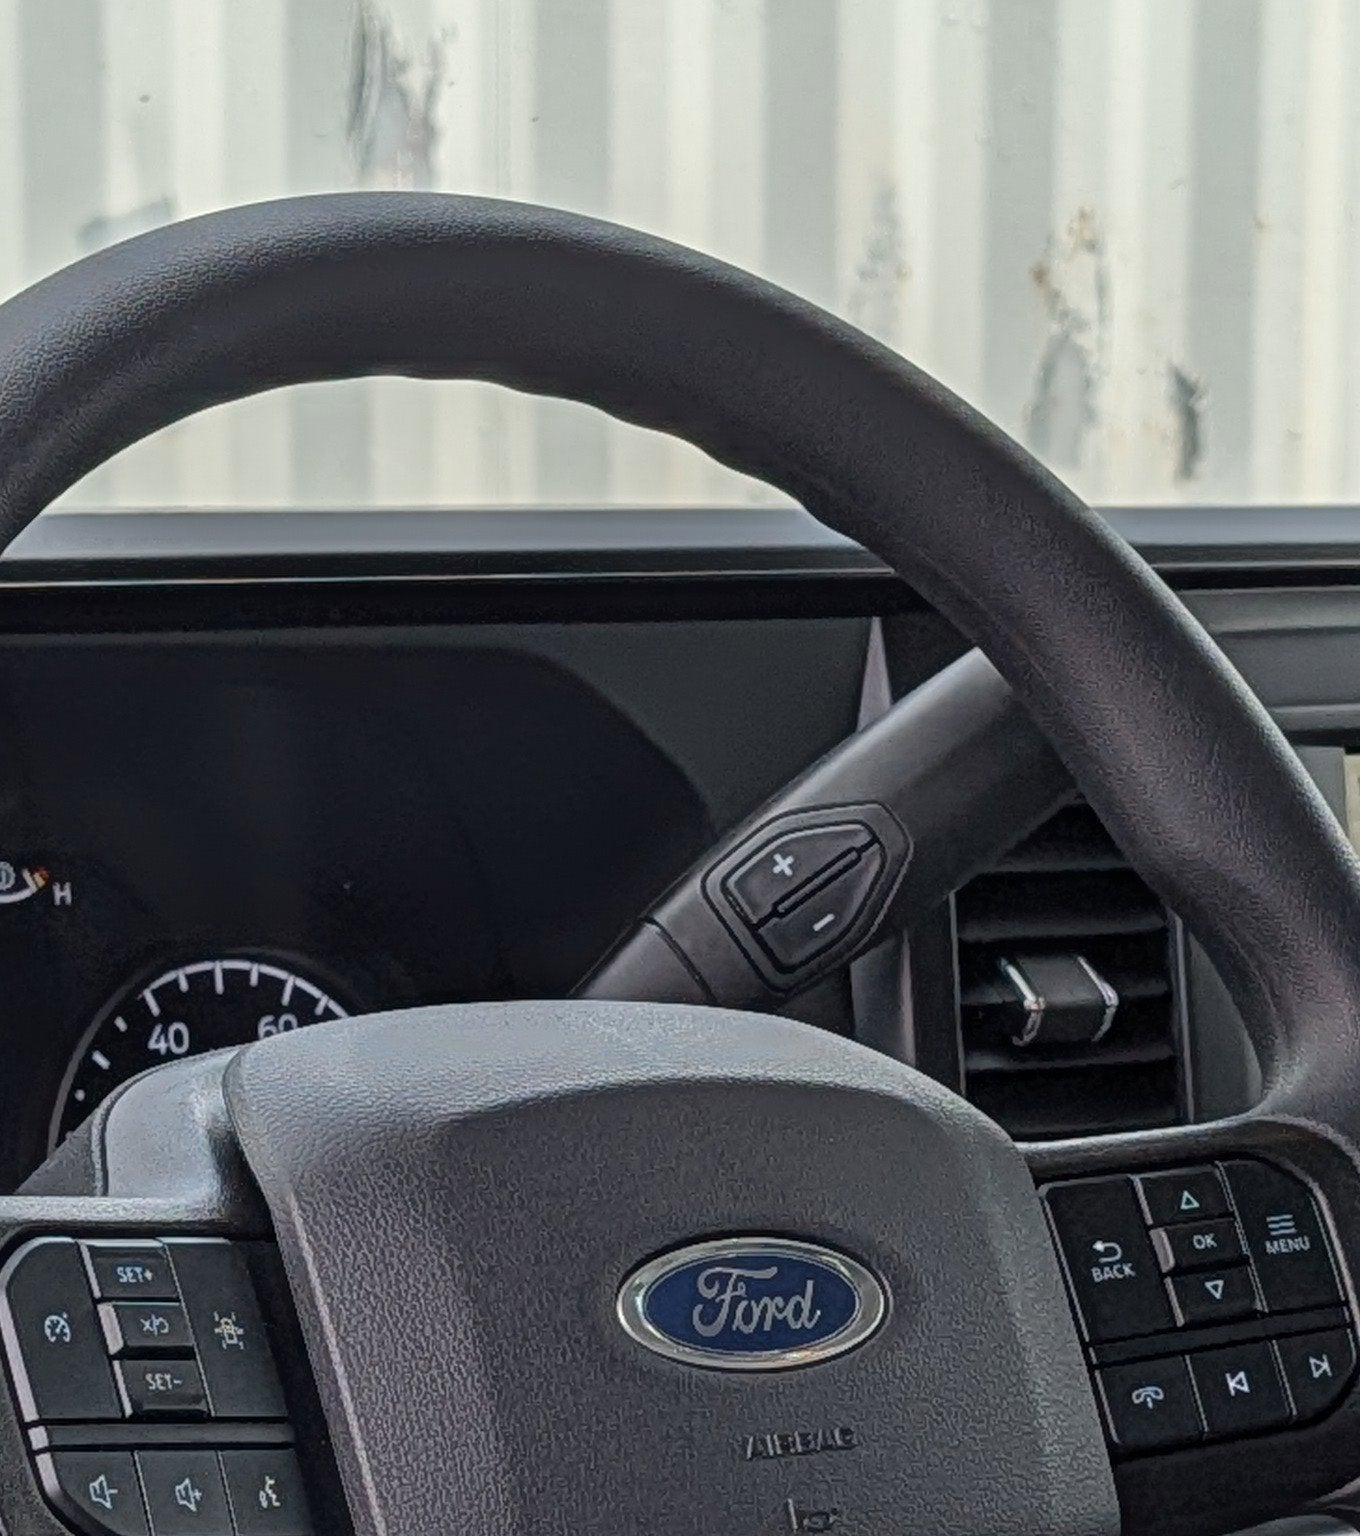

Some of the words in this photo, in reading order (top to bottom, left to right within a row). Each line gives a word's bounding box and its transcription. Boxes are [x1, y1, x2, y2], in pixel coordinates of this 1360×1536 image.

[53, 882, 72, 906] H
[147, 1019, 190, 1055] 40
[1191, 1231, 1219, 1252] OK
[1264, 1233, 1311, 1257] MENU
[1091, 1259, 1137, 1283] BACK
[692, 1265, 823, 1340] Ford
[743, 1426, 858, 1463] AIRBAG
